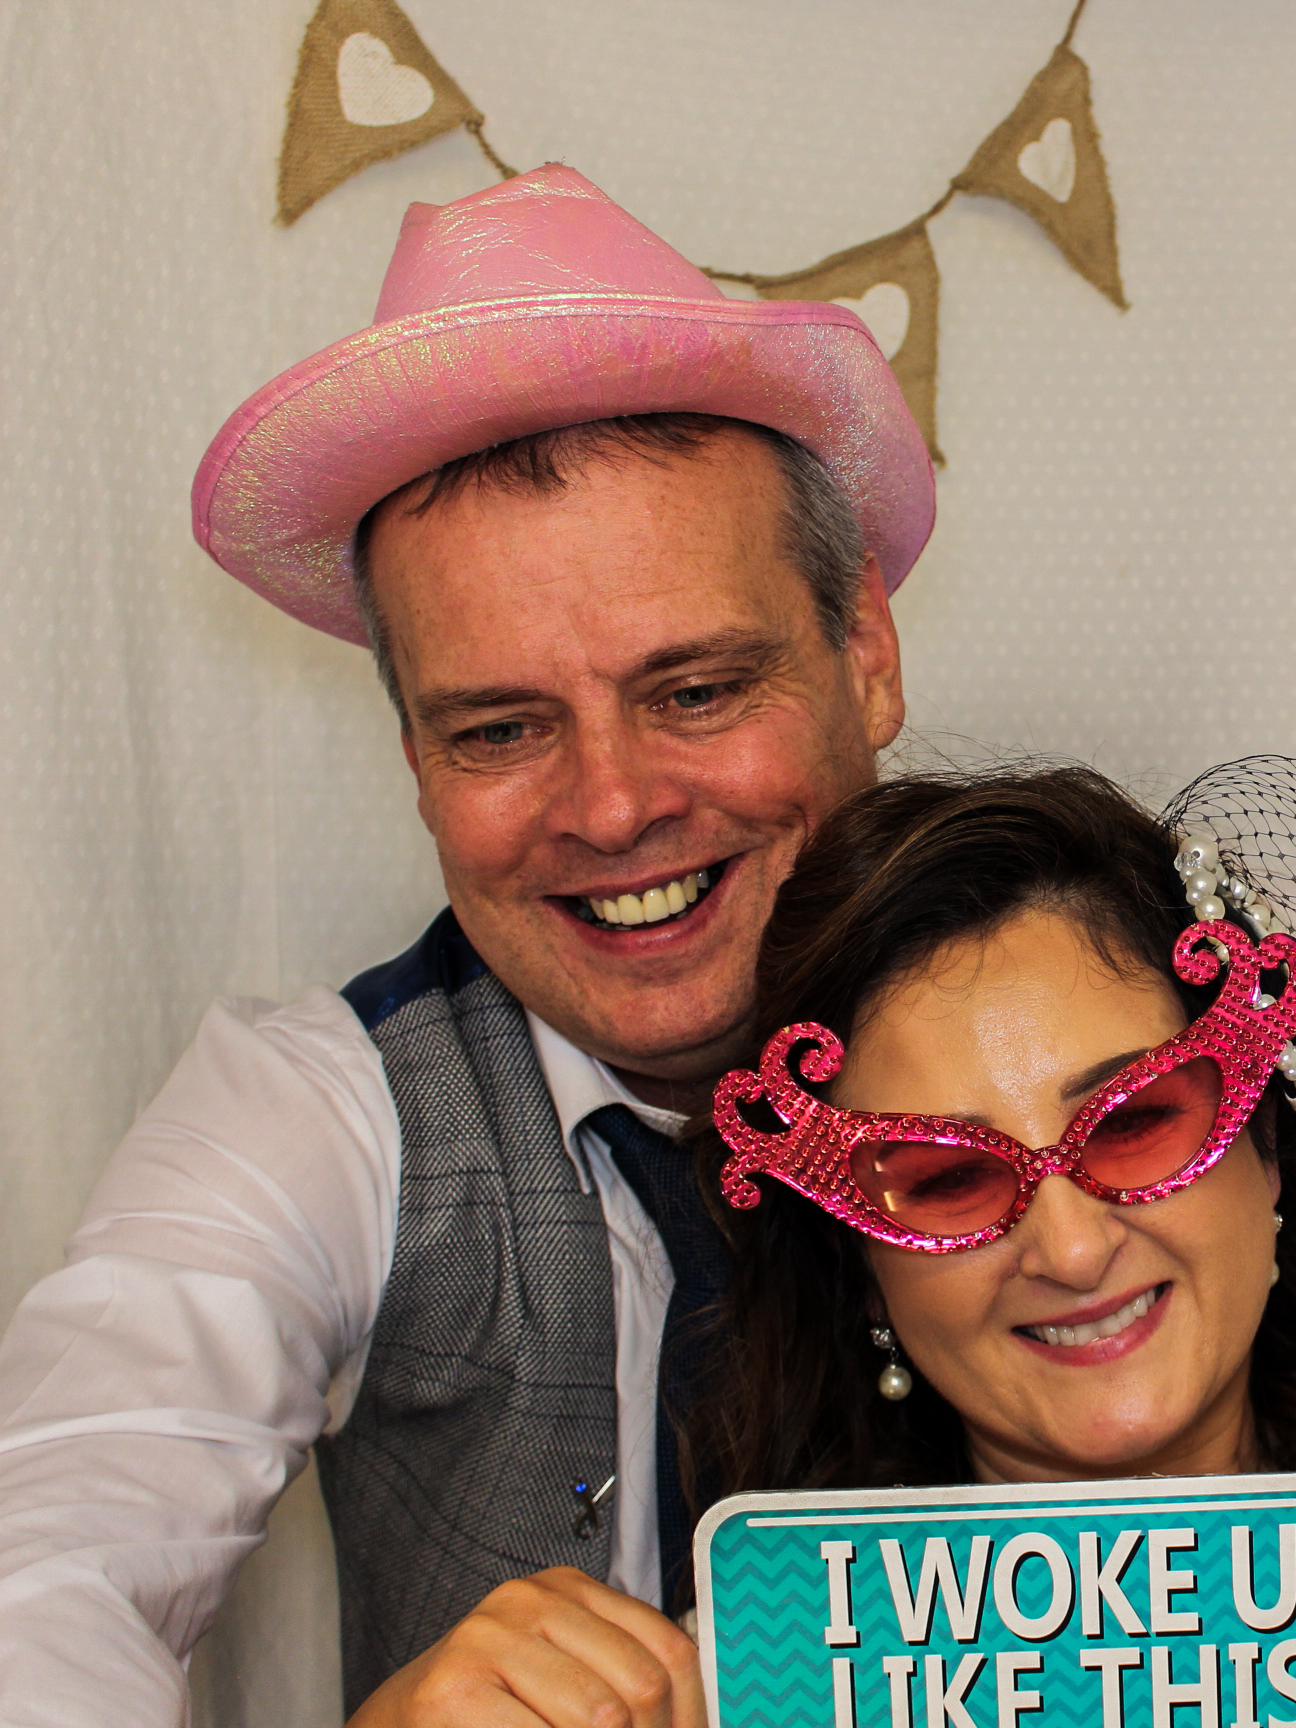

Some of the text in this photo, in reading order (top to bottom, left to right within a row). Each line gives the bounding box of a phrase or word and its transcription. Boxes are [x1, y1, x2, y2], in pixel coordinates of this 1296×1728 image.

[820, 1540, 860, 1646] I
[878, 1527, 1202, 1643] WOKE
[831, 1650, 1044, 1728] LIKE
